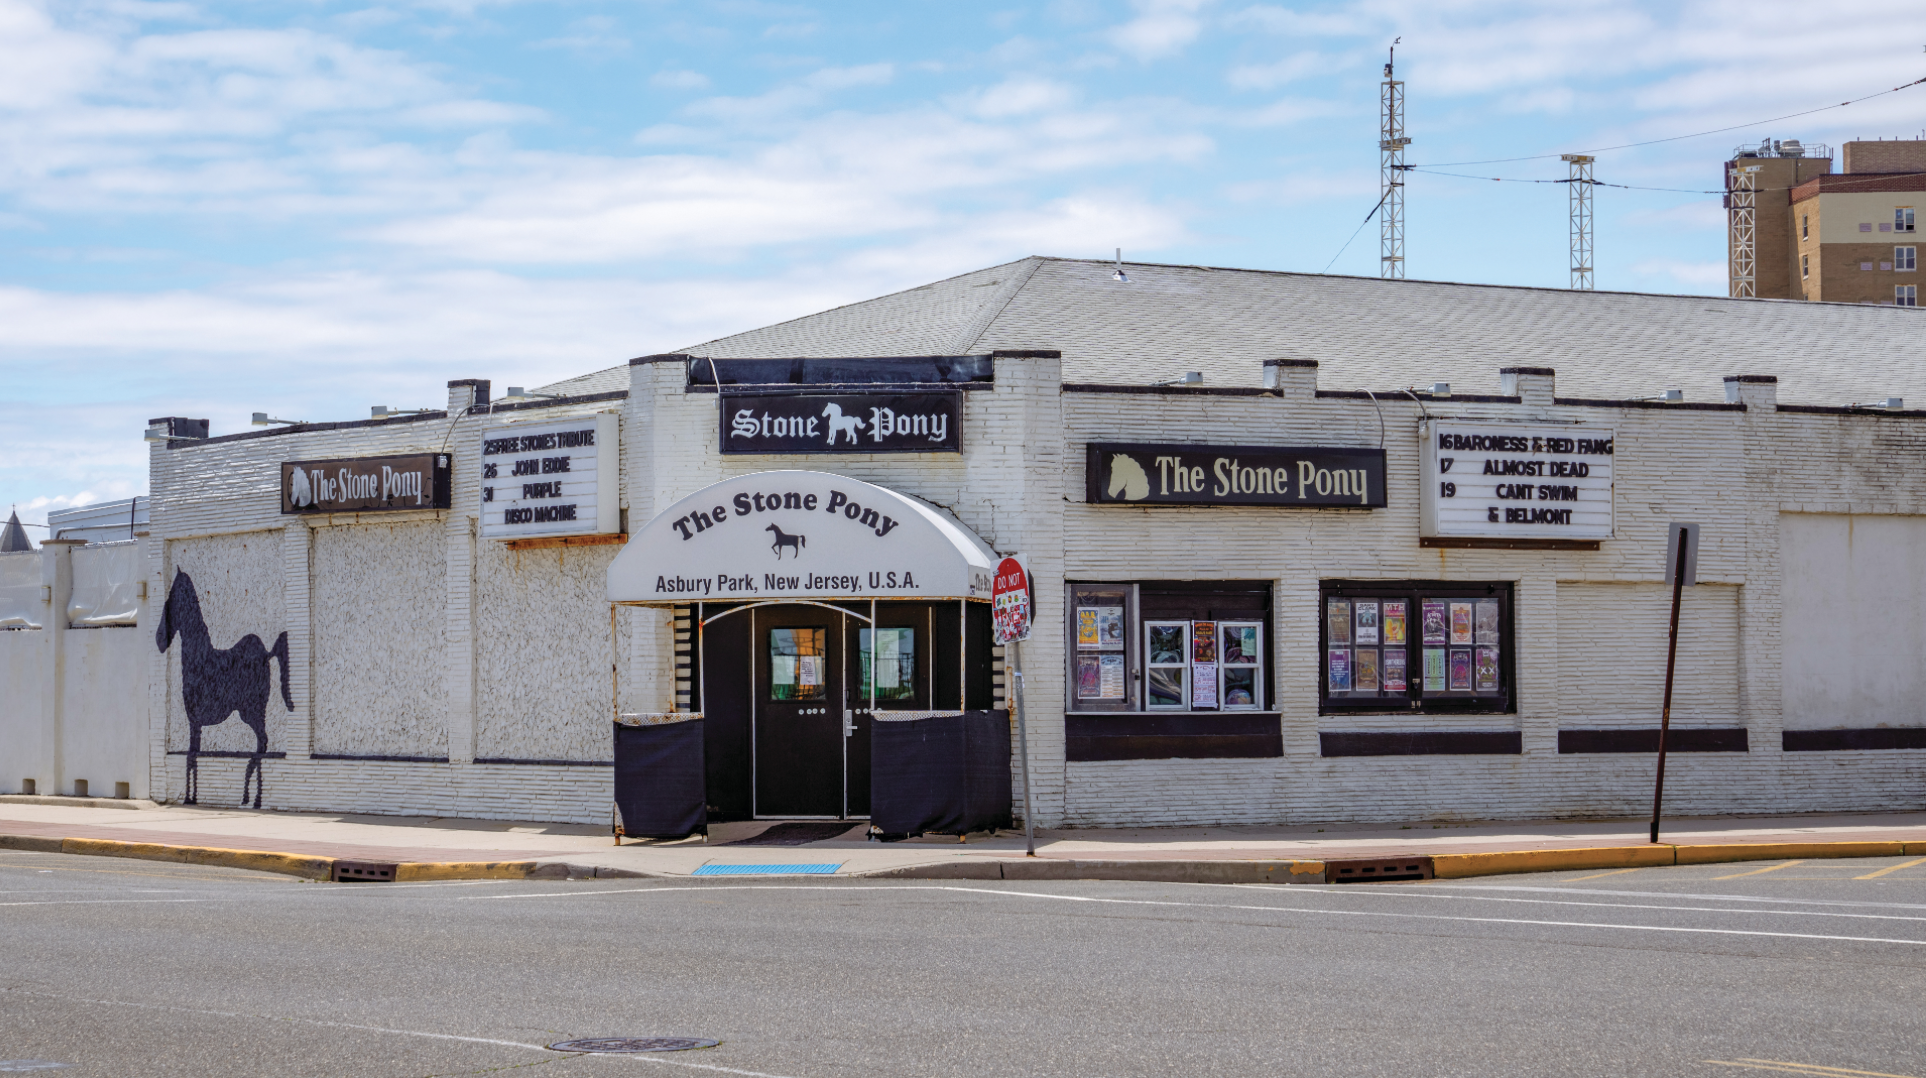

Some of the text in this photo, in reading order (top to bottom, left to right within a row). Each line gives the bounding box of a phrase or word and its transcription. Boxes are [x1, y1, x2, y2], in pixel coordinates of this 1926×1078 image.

[730, 406, 948, 442] Stone Pony
[520, 433, 557, 452] STONES
[556, 429, 595, 449] TRIBUTE
[1439, 433, 1454, 450] 16
[1453, 434, 1529, 452] BARONESS
[1546, 437, 1575, 454] RED
[1577, 438, 1613, 455] FANG
[483, 456, 571, 479] 26 JOHN EDDIE
[1440, 457, 1590, 478] 17 ALMOST DEAD
[309, 465, 422, 505] The Stone Pony
[522, 480, 562, 499] PURPLE
[1155, 456, 1368, 504] The Stone Pony
[1440, 481, 1578, 502] 19 CANT SWIM
[504, 503, 577, 524] DISCO MACHINE
[672, 489, 900, 542] The Stone Pony
[1487, 506, 1573, 525] & BELMONT
[655, 571, 920, 595] Asbury Park, New Jersey, U.S.A.
[997, 576, 1007, 590] DO
[1008, 572, 1021, 587] NOT
